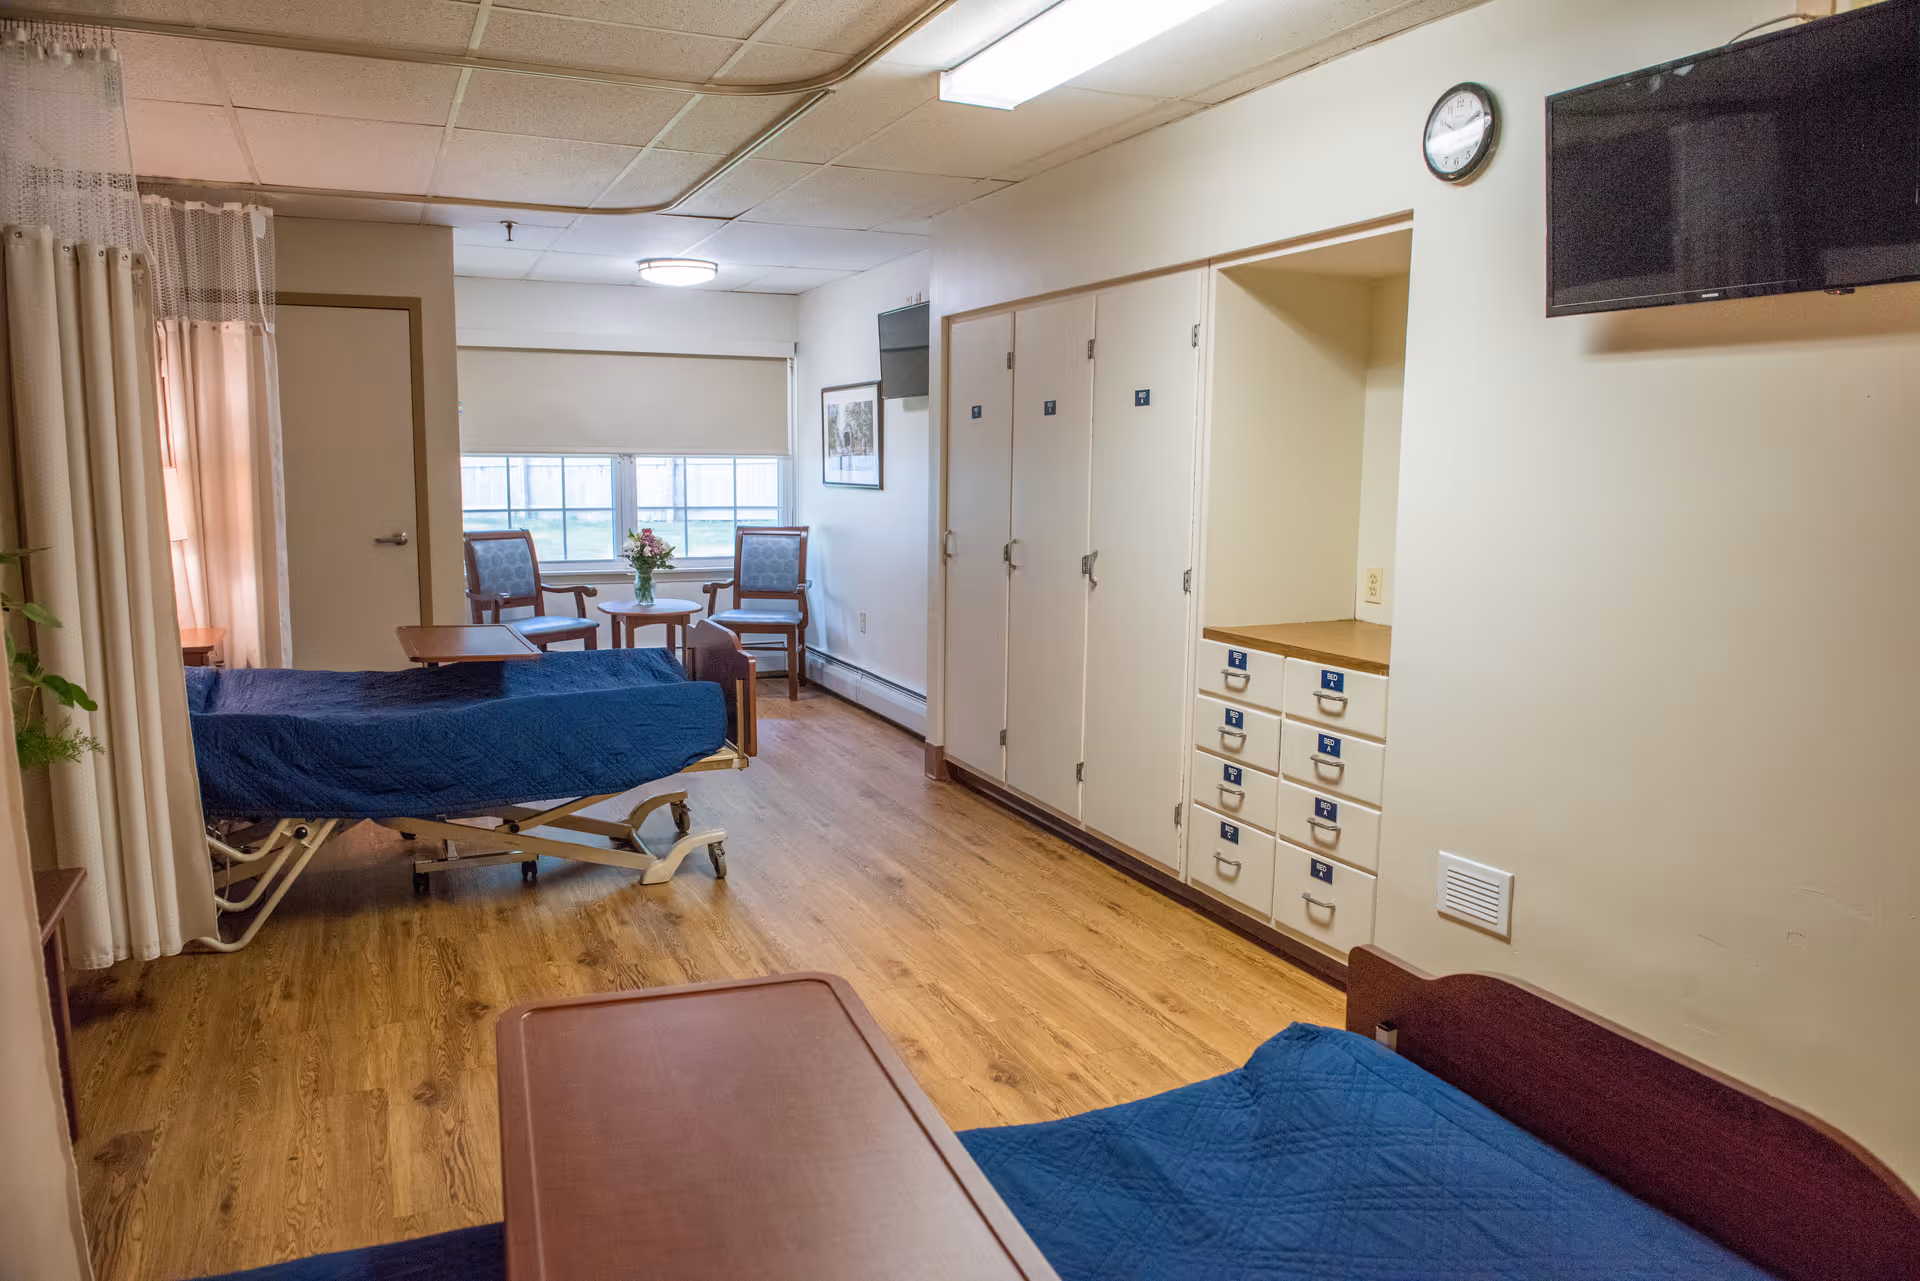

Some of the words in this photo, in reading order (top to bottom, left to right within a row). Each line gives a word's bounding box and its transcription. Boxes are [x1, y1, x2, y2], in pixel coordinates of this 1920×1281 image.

[1233, 651, 1242, 659] BED
[1327, 673, 1338, 681] BED
[1230, 710, 1239, 718] BED
[1324, 738, 1335, 746] BED
[1228, 767, 1237, 775] BED
[1320, 801, 1331, 810] BED
[1225, 825, 1234, 833] BED
[1316, 863, 1327, 871] BED
